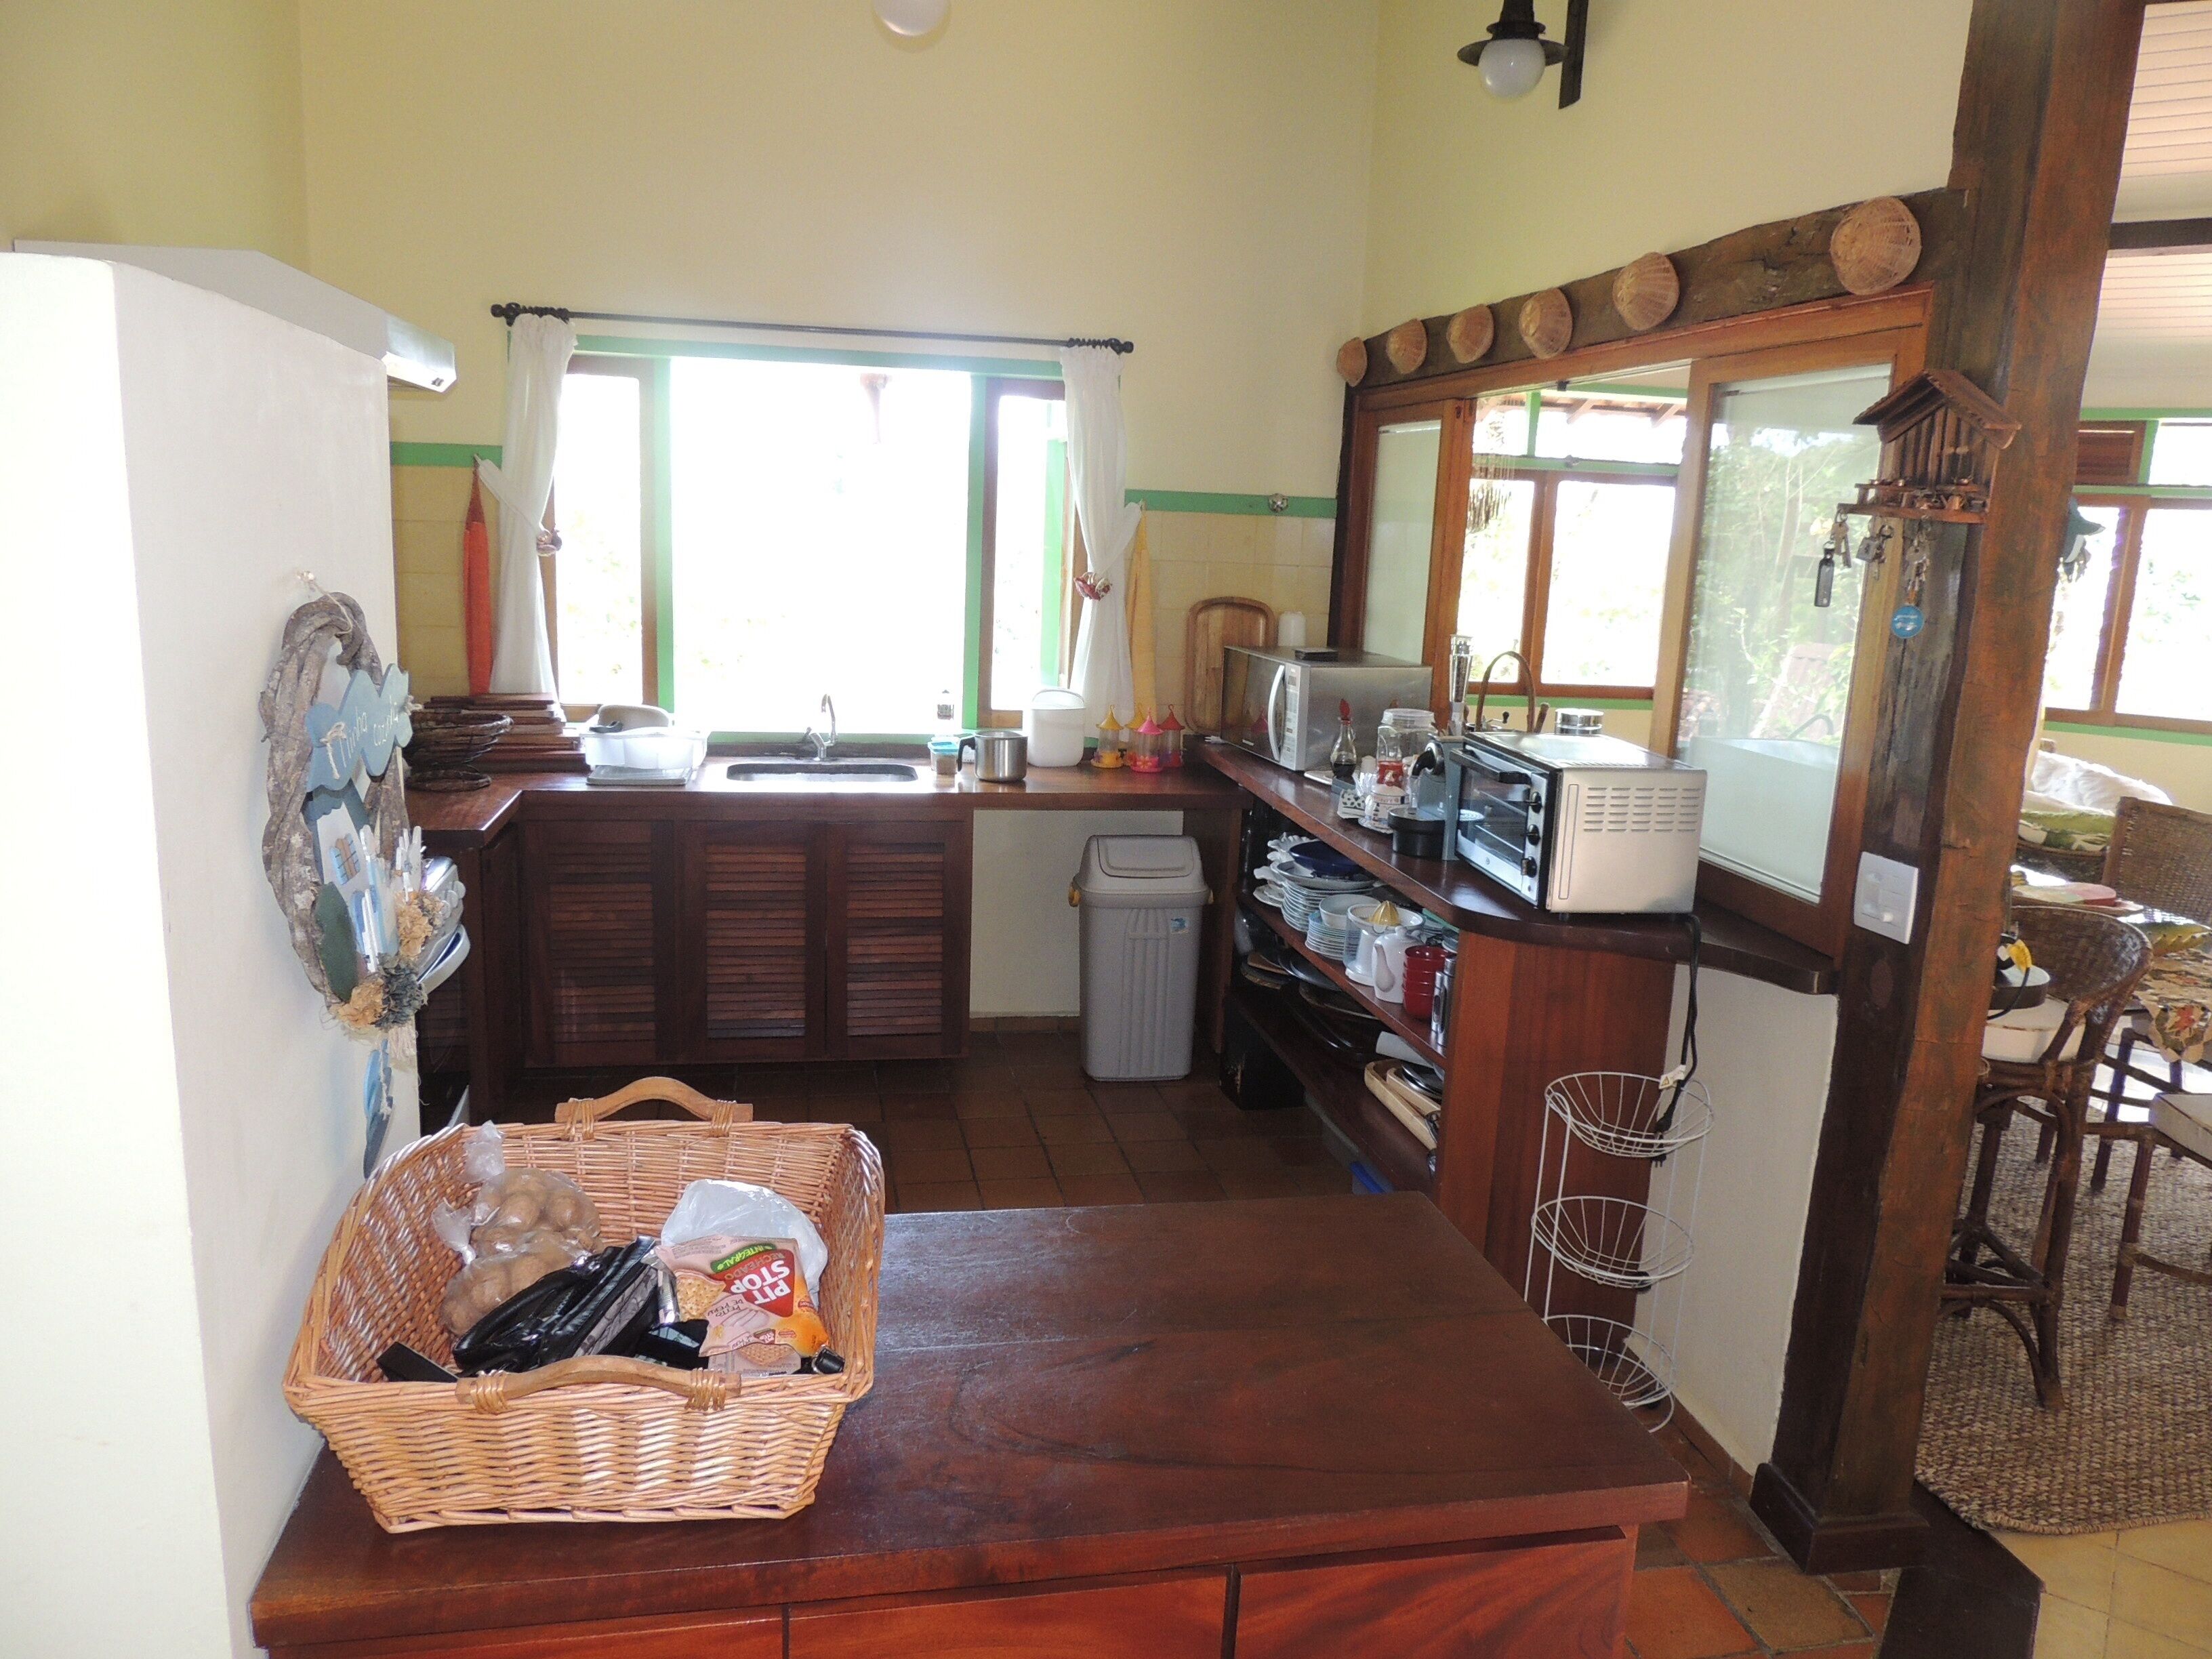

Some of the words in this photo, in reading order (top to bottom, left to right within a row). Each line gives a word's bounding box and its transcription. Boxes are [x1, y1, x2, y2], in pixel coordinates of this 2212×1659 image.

[722, 1244, 764, 1267] INTEGRAL
[724, 1252, 785, 1280] RECHEADO
[730, 1260, 790, 1294] STOP
[752, 1279, 792, 1305] PIT
